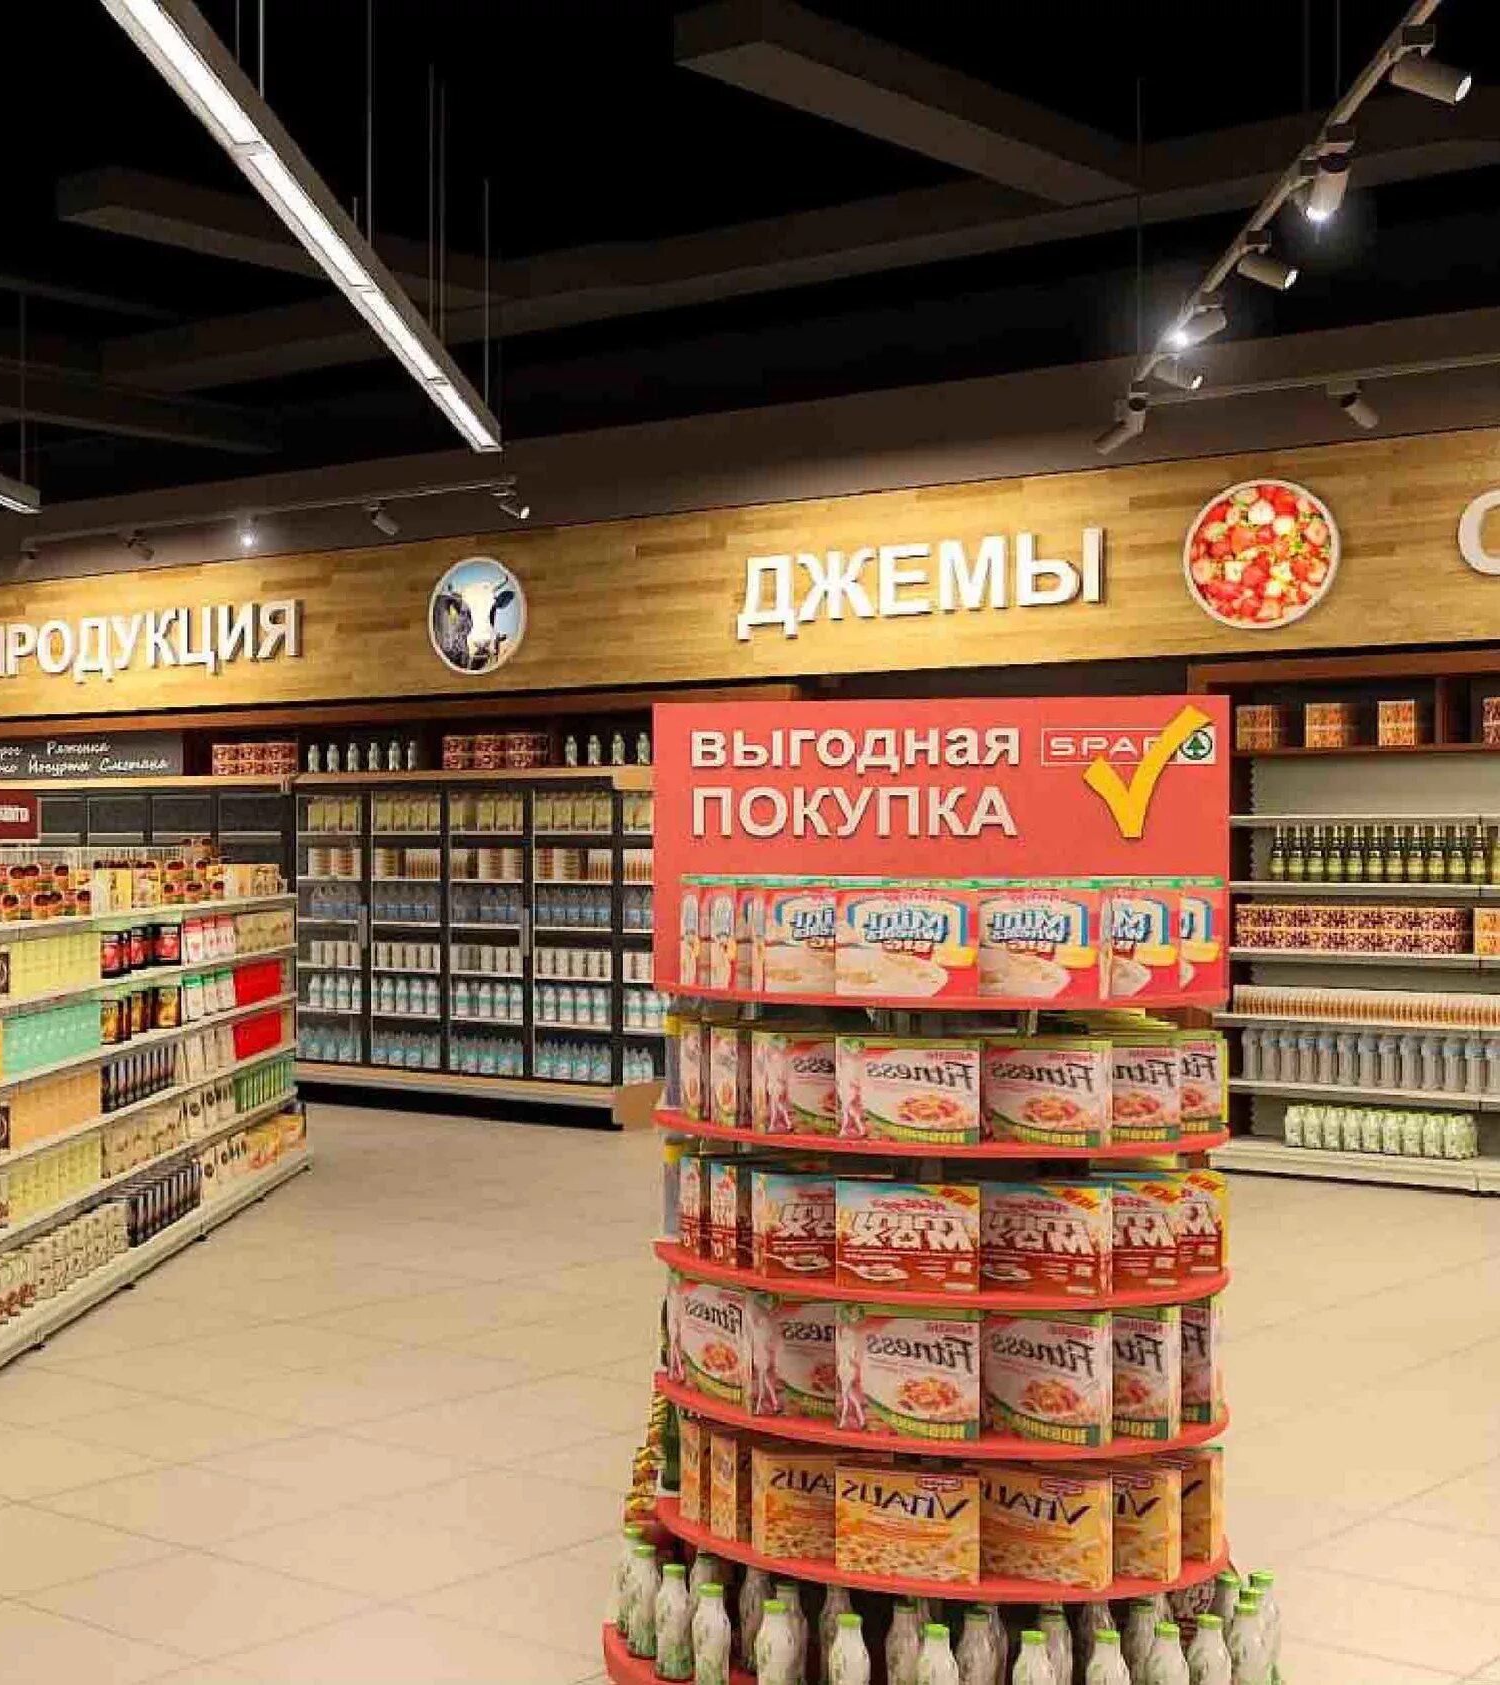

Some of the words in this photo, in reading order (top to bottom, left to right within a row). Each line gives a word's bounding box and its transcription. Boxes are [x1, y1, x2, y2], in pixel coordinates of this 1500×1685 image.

[737, 527, 1105, 641] ДЖЕМЫ
[690, 726, 1019, 775] выгодная
[690, 785, 1018, 838] ПОКУПКА
